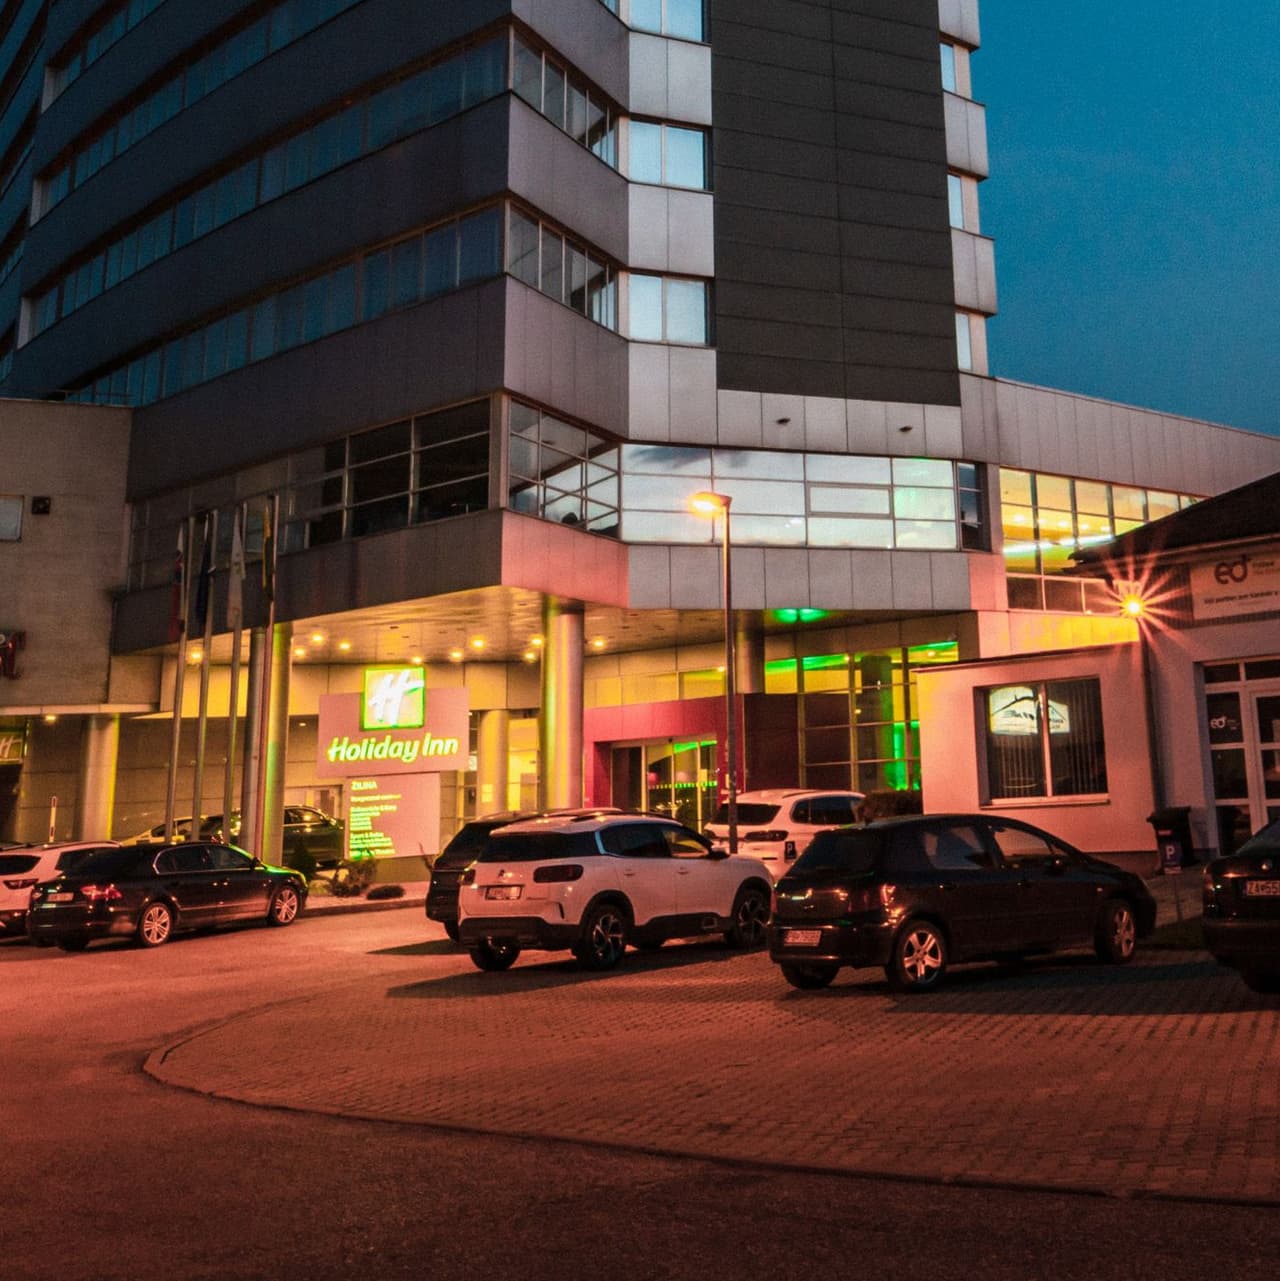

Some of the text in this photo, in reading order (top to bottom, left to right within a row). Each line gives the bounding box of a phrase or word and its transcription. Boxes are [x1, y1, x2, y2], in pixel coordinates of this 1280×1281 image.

[328, 732, 458, 764] Holiday Inn
[1165, 845, 1176, 860] P
[1249, 880, 1260, 895] ZA
